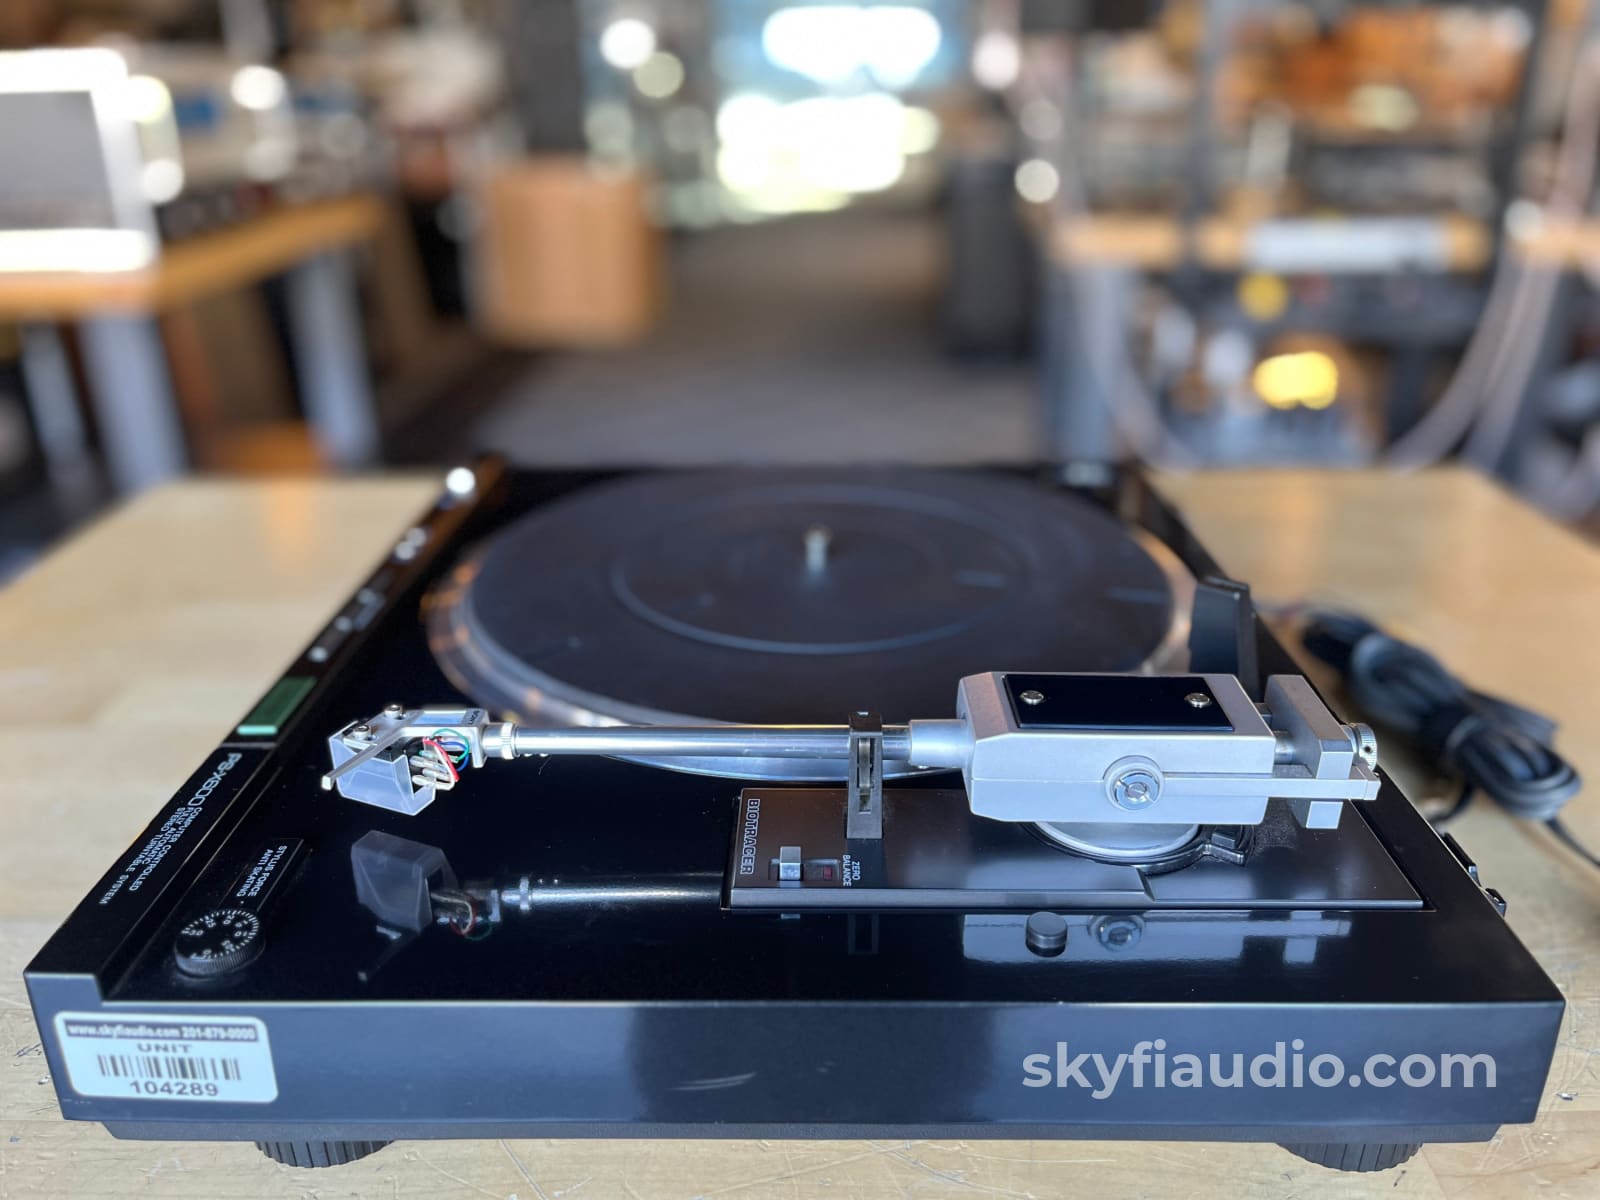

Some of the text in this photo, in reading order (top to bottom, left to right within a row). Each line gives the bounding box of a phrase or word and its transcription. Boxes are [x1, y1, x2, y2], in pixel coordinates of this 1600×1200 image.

[188, 752, 243, 806] PS-X600
[98, 807, 186, 904] STEREO TURNTABLE SYSTEM
[129, 807, 203, 891] COMPUTER CONTROLLED
[141, 807, 194, 865] FULLY AUTOMATIC
[740, 798, 760, 874] BIOTRACER
[236, 849, 274, 897] ANTI SKATING
[247, 845, 288, 897] STYLUS FORCE
[842, 854, 852, 887] BALANCE
[851, 860, 861, 881] ZERO
[137, 1043, 193, 1054] UNIT
[130, 1080, 219, 1097] 104289
